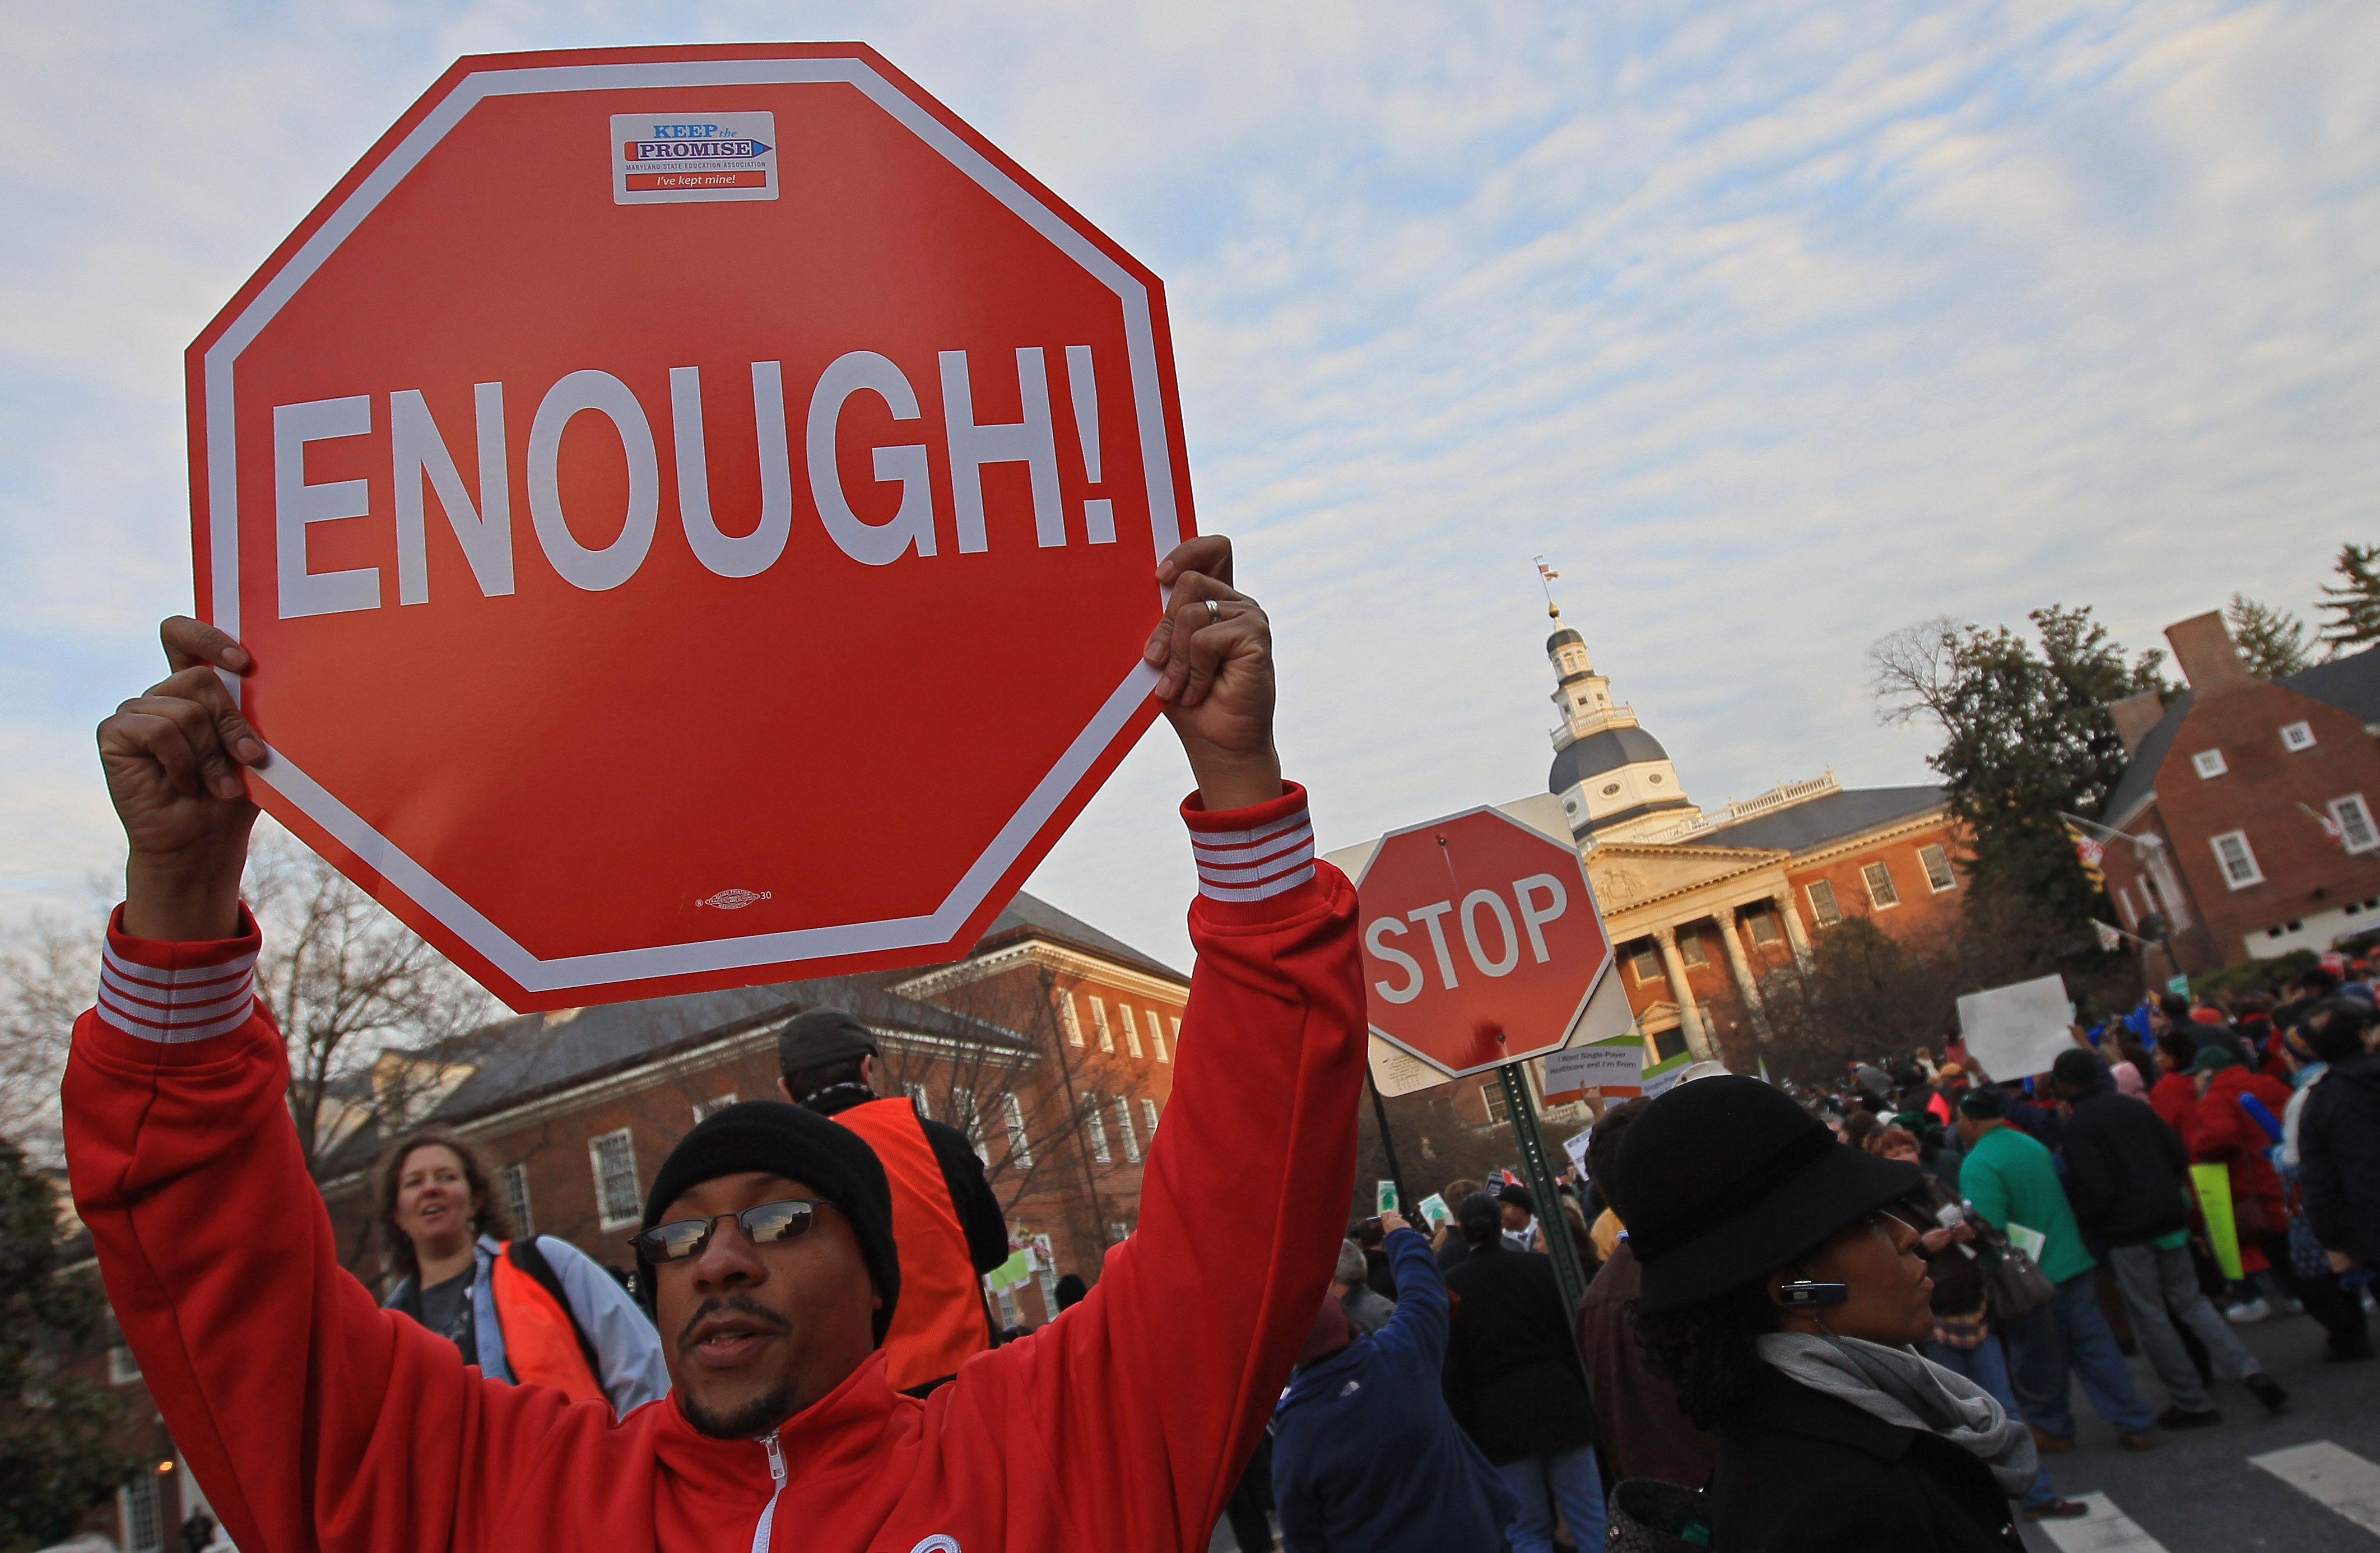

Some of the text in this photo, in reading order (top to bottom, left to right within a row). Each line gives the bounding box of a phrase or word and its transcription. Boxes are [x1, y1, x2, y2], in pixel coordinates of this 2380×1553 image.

[653, 124, 737, 138] KEEP the
[639, 142, 750, 158] PROMISE
[657, 174, 736, 187] I've kept mine!
[273, 345, 1117, 620] ENOUGH!
[760, 891, 771, 900] 30
[1365, 873, 1567, 1005] STOP
